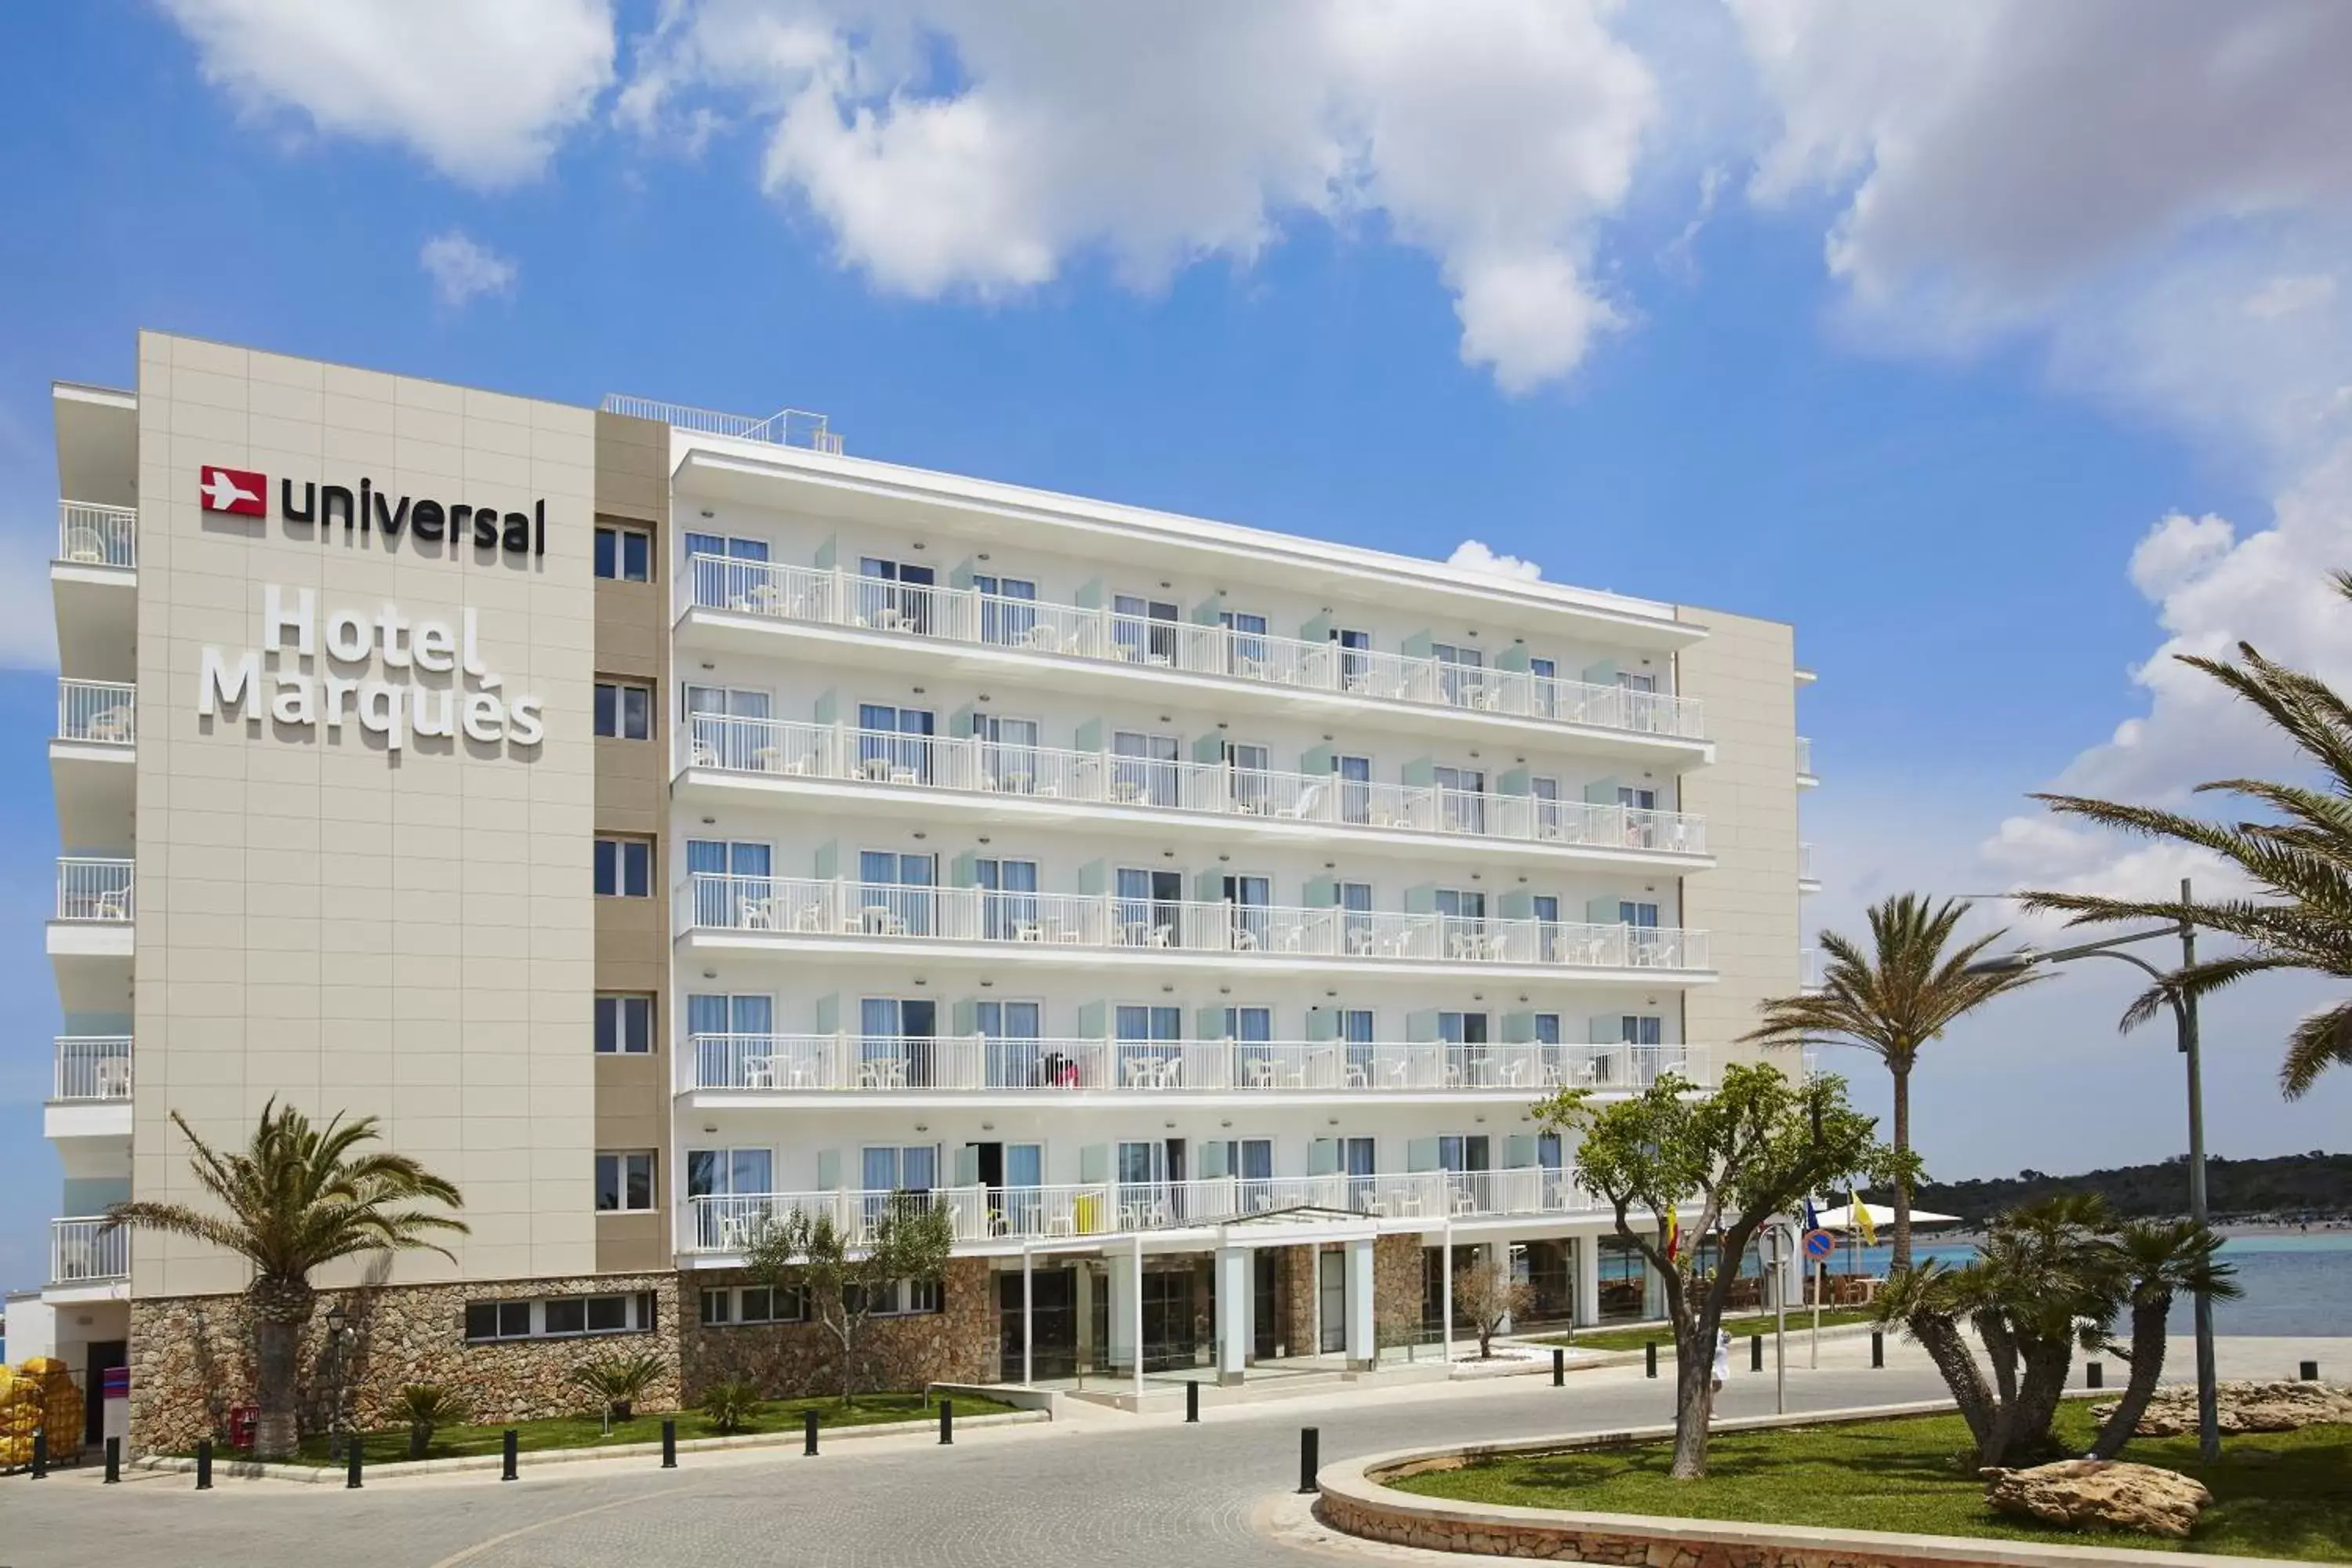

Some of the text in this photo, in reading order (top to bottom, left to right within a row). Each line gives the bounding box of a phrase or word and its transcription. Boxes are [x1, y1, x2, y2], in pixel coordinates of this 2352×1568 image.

[281, 477, 545, 556] universal
[263, 584, 487, 677] Hotel
[198, 646, 544, 750] Marqués
